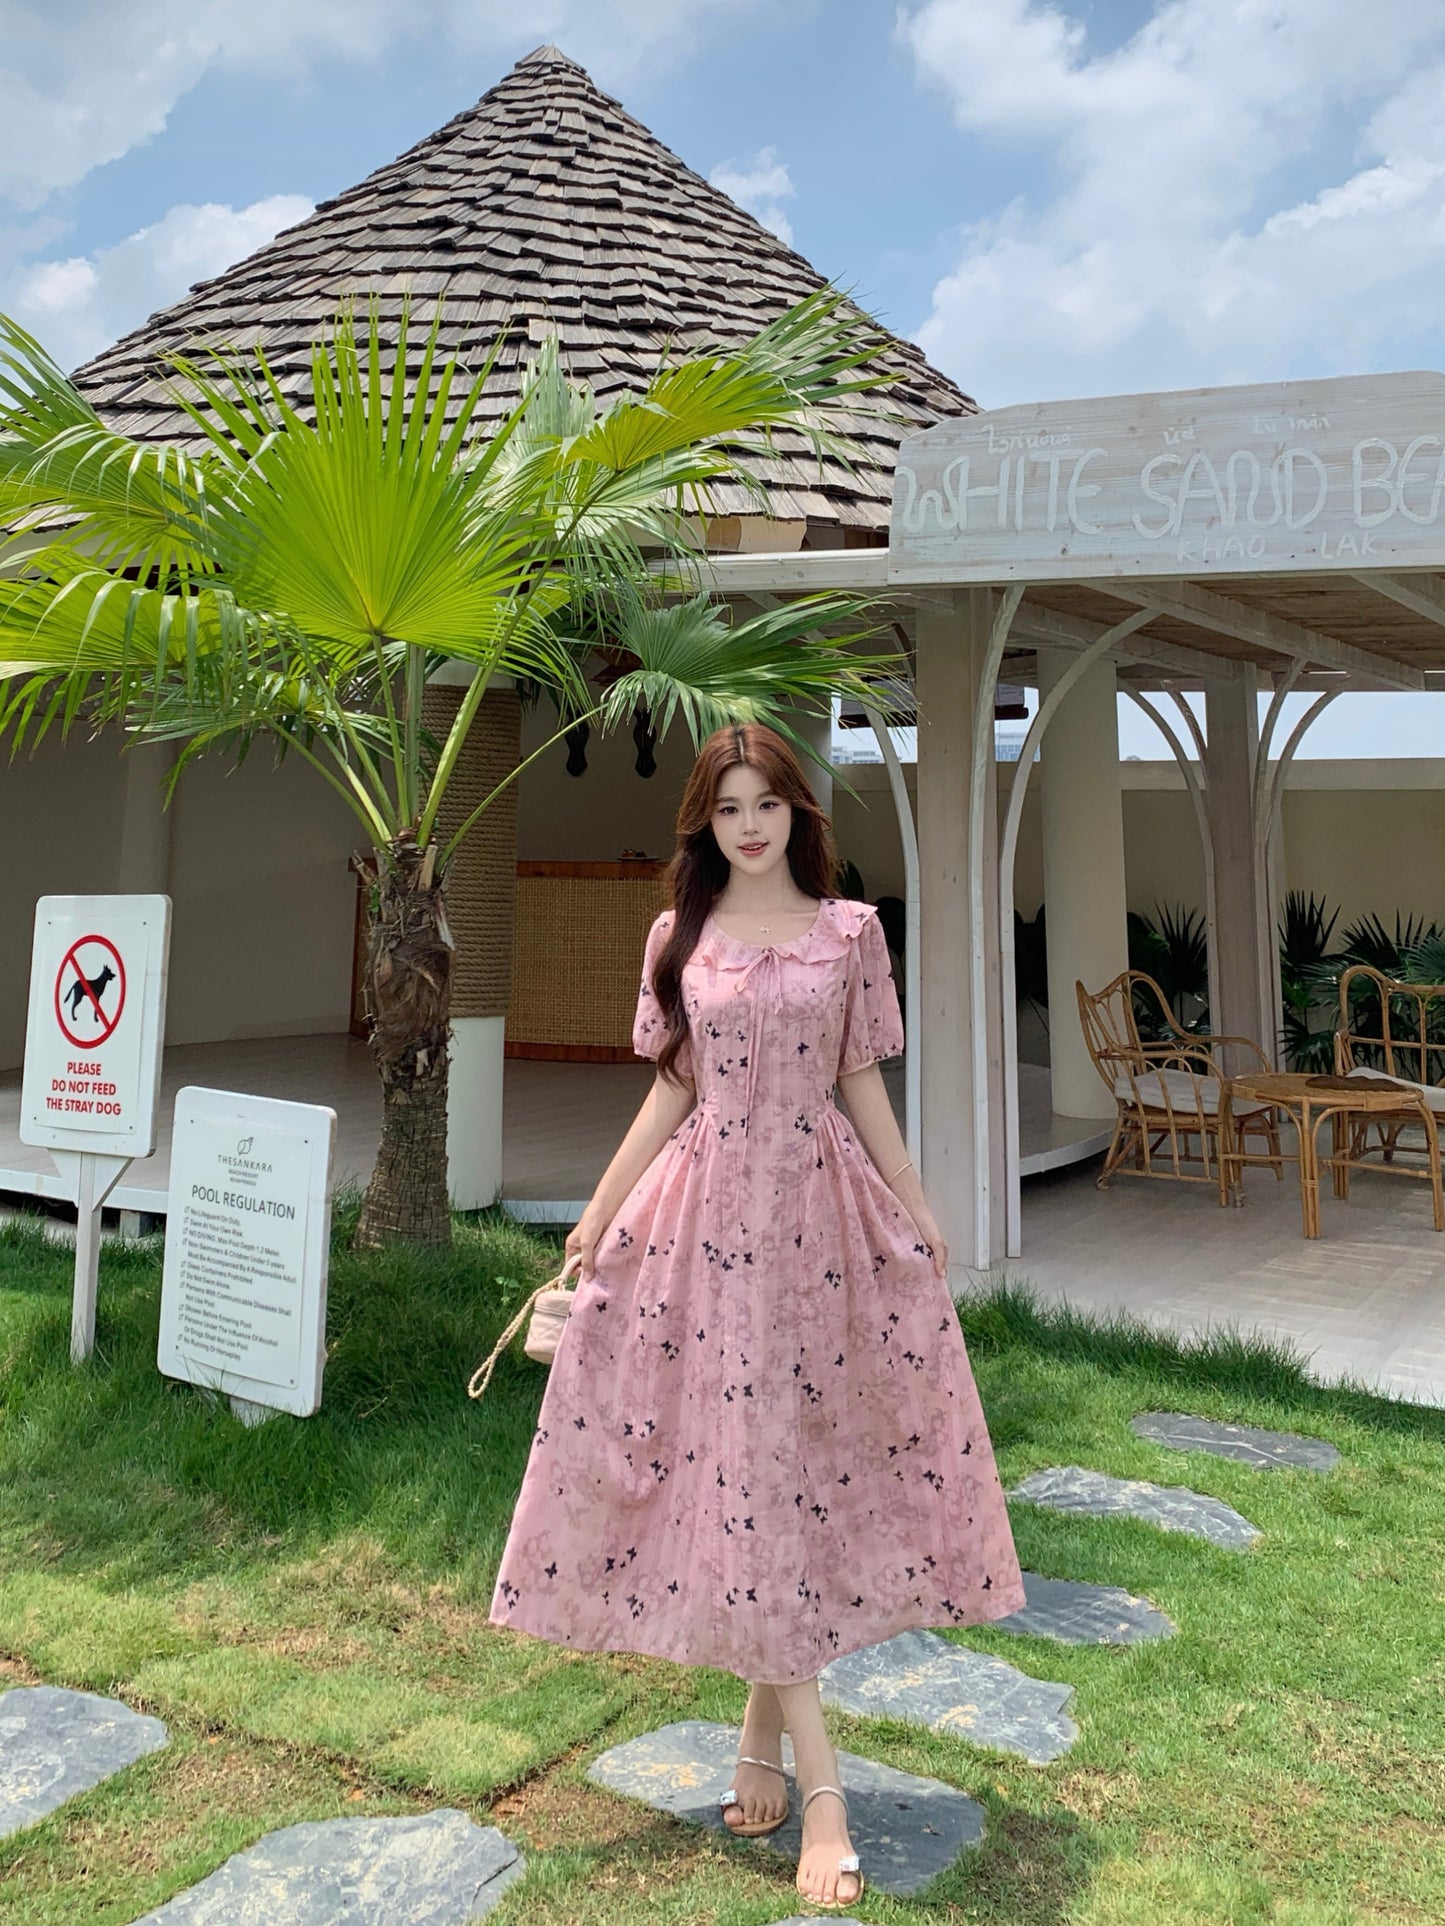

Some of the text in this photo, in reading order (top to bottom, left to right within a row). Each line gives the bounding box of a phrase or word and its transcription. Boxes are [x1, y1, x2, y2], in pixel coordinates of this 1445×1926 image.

[894, 435, 1445, 539] WHITE SAND BE
[1176, 531, 1378, 562] KHAO LAK
[67, 1062, 101, 1076] PLEASE
[52, 1080, 117, 1096] DO NOT FEED
[46, 1097, 122, 1116] THE STRAY DOG
[192, 1184, 296, 1220] POOL REGULATION
